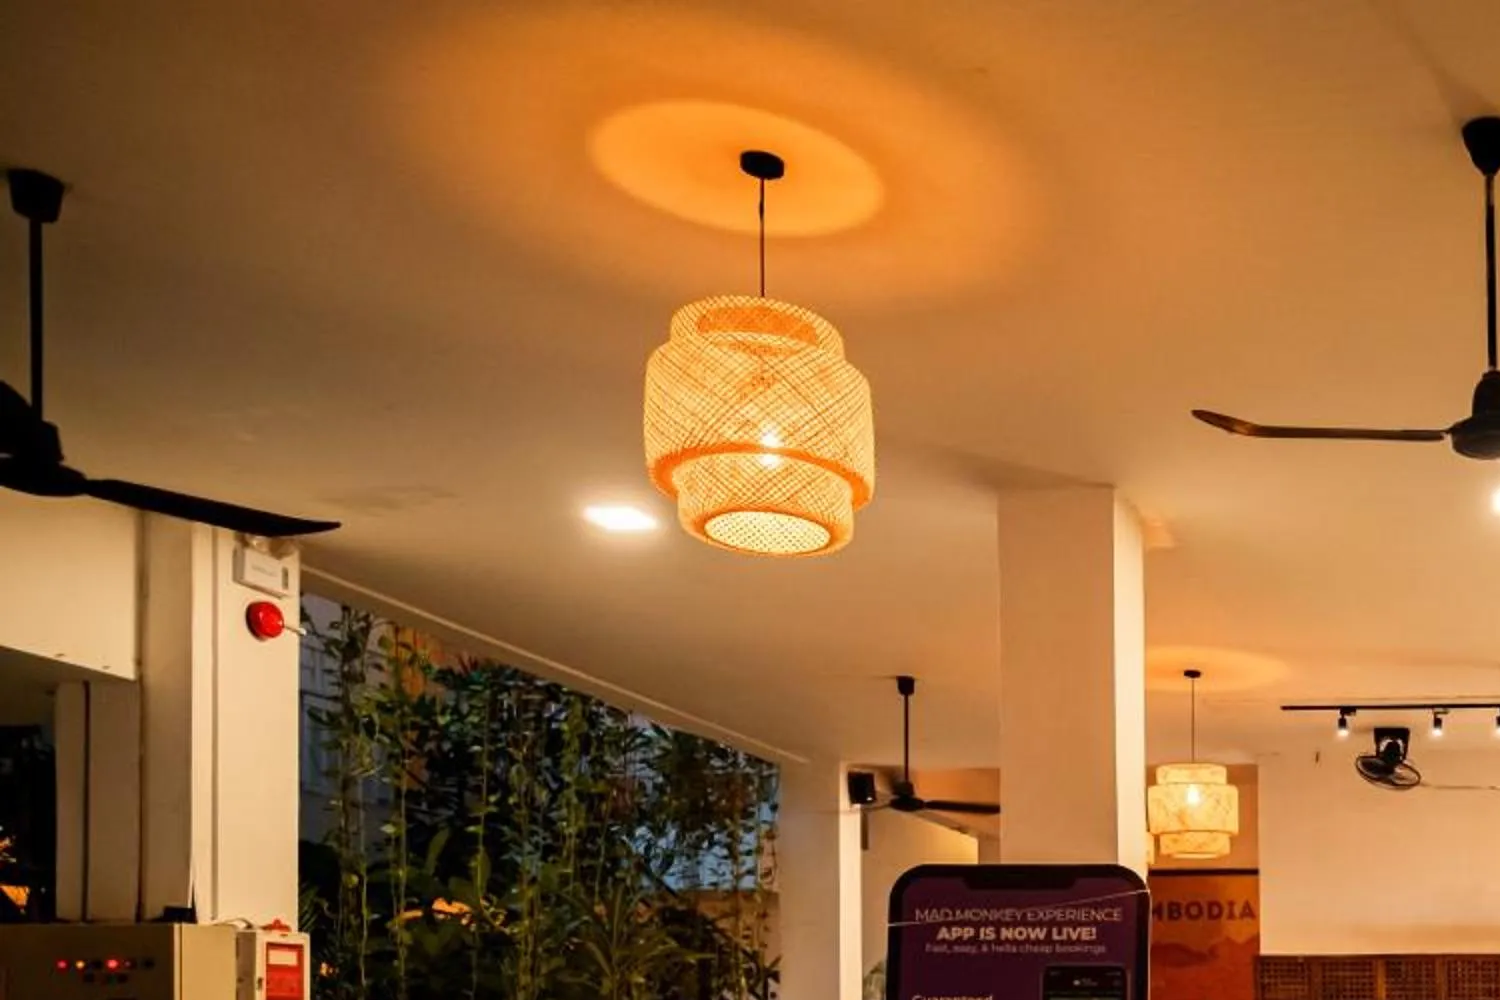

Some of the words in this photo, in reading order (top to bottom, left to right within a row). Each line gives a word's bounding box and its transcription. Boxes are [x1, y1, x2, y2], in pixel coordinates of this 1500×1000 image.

[915, 908, 953, 922] MAD
[955, 908, 1026, 922] MONKEY
[1028, 908, 1122, 922] EXPERIENCE
[936, 927, 974, 941] APP
[979, 927, 997, 941] IS
[1001, 927, 1047, 941] NOW
[1052, 926, 1097, 941] LIVE!
